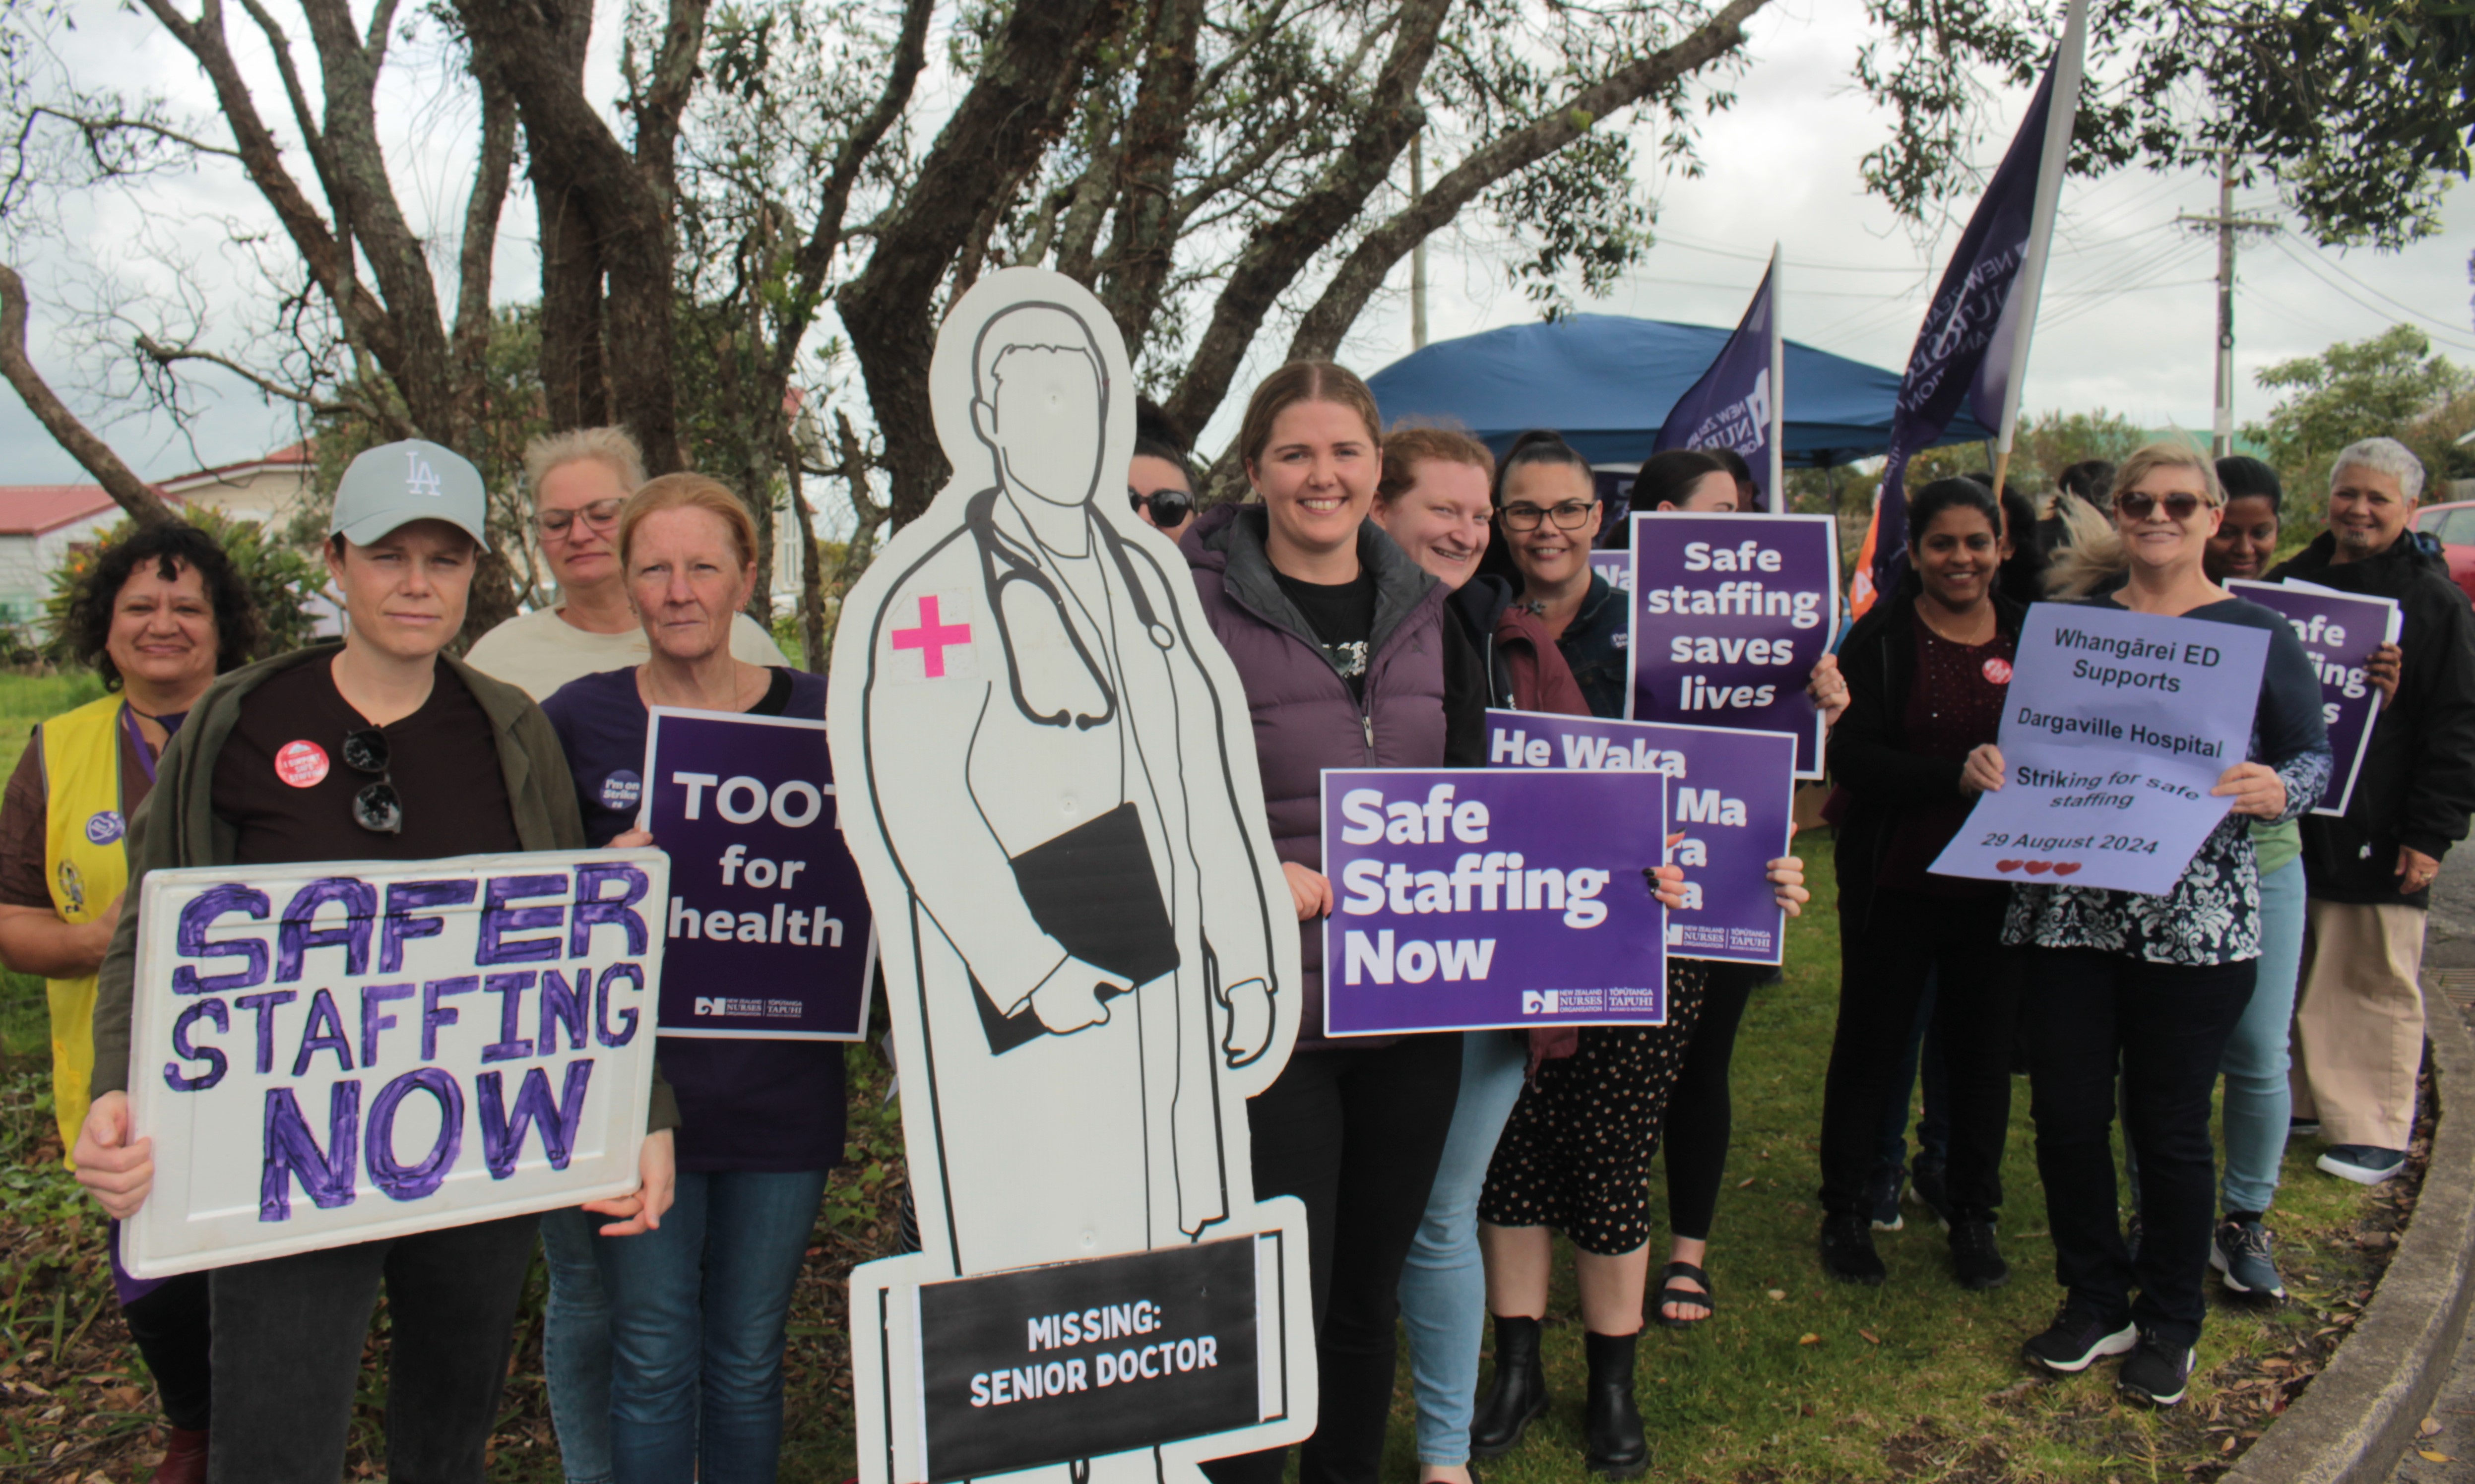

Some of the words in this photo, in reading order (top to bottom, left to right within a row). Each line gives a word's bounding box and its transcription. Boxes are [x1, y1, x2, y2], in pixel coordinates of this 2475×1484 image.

[405, 451, 441, 496] LA
[1685, 541, 1781, 571] Safe
[1648, 583, 1820, 628] staffing
[1671, 636, 1793, 665] saves
[2055, 628, 2177, 661] Whangārei
[2184, 644, 2221, 667] ED
[1680, 677, 1776, 710] lives
[2073, 660, 2181, 692] Supports
[1491, 728, 1551, 766] He
[1562, 735, 1686, 778] Waka
[2018, 708, 2123, 739] Dargaville
[2131, 724, 2223, 757] Hospital
[603, 789, 637, 800] Strike
[605, 779, 624, 790] I'm
[625, 782, 640, 790] on
[673, 771, 842, 830] TOO
[2017, 766, 2103, 790] Striking
[2107, 771, 2142, 785] for
[2146, 775, 2200, 801] safe
[2050, 793, 2134, 809] staffing
[1341, 783, 1489, 845] Safe
[1676, 787, 1747, 827] Ma
[1981, 833, 2009, 847] 29
[2011, 833, 2094, 852] August
[2098, 834, 2159, 855] 2024
[719, 844, 806, 889] for
[1342, 852, 1610, 929] Staffing
[172, 861, 650, 994] SAFER
[668, 897, 844, 947] health
[1684, 931, 1724, 942] NURSES
[1730, 936, 1770, 947] TAPUHI
[1345, 929, 1496, 985] Now
[1560, 996, 1602, 1006] NURSES
[1609, 996, 1653, 1006] TAPUHI
[163, 962, 644, 1092] STAFFING
[258, 1058, 594, 1222] NOW
[1028, 1299, 1162, 1353] MISSING:
[970, 1359, 1088, 1408] SENIOR
[1096, 1335, 1218, 1388] DOCTOR
